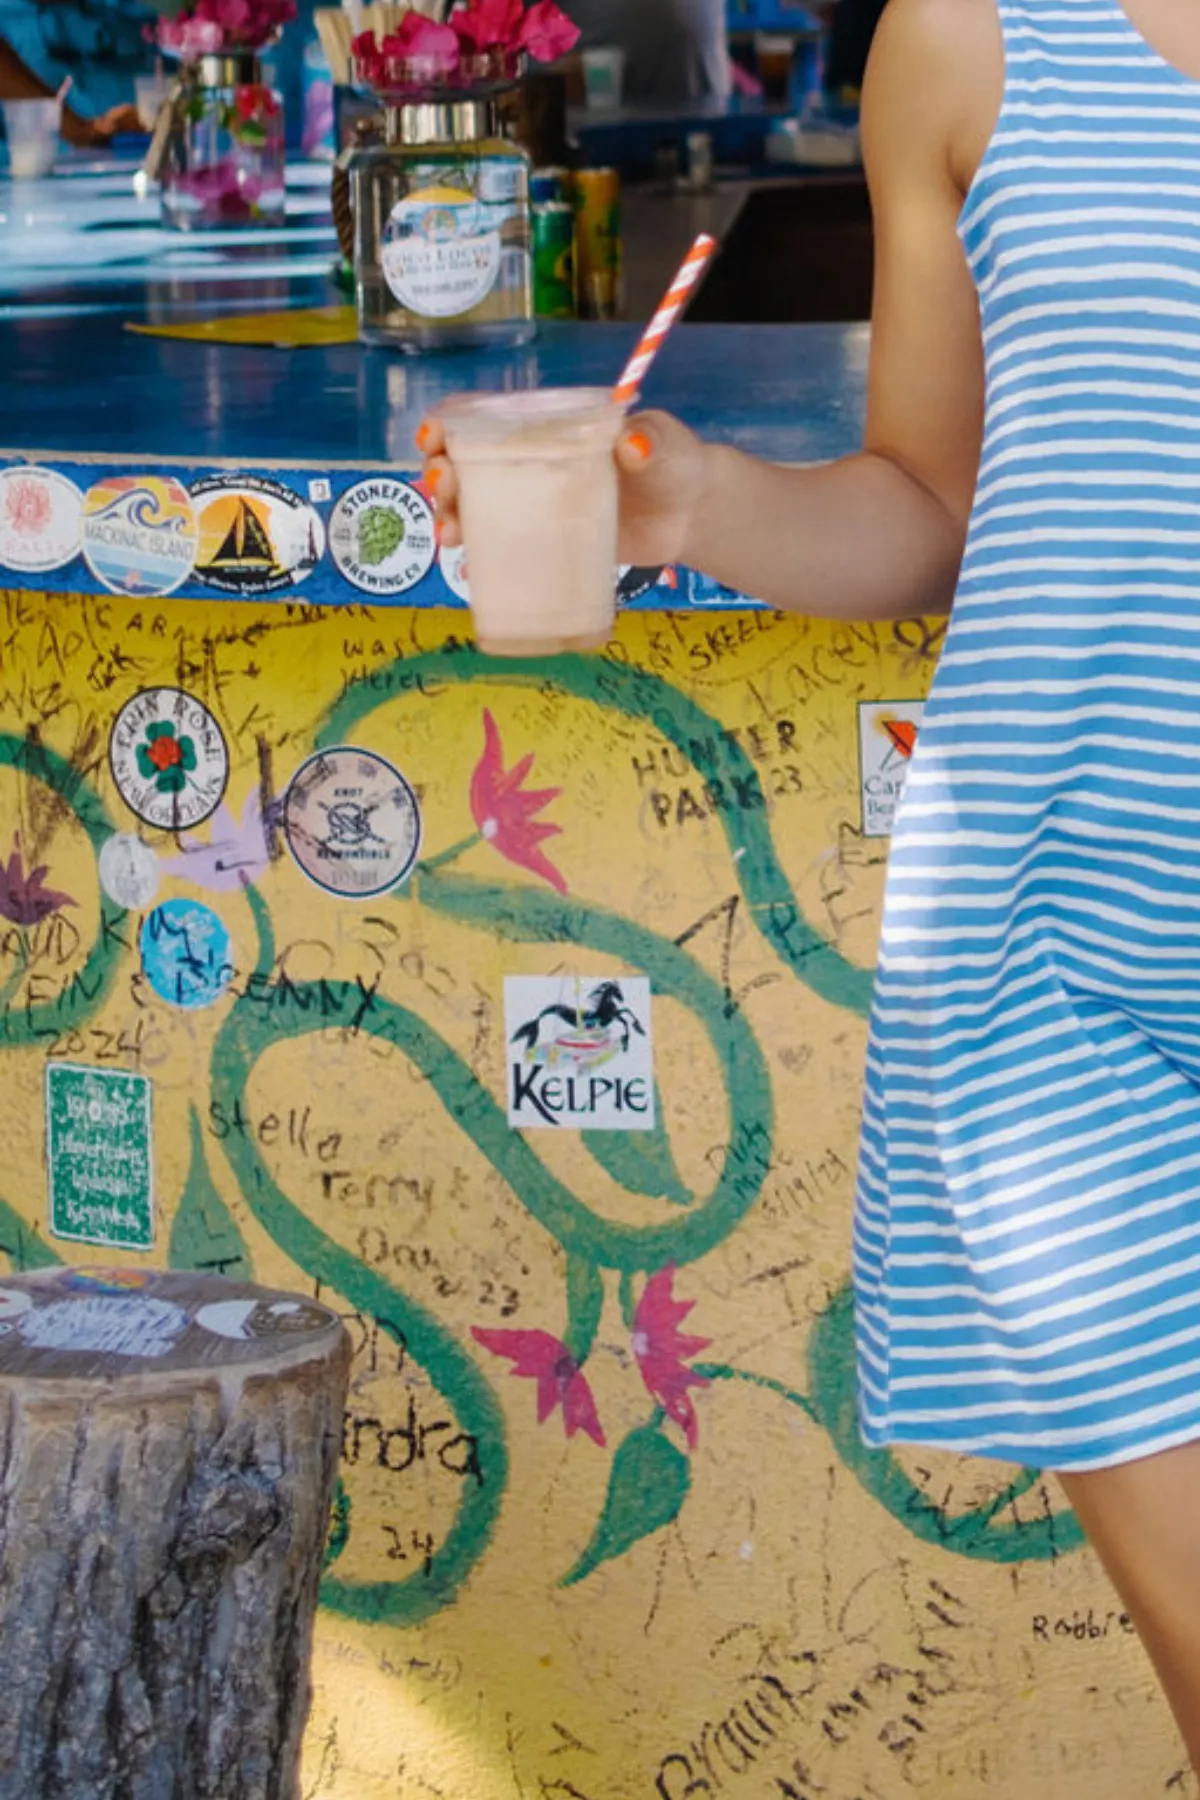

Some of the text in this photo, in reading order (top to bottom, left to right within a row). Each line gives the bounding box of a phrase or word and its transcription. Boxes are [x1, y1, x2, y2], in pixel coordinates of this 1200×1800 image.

[341, 482, 428, 523] STONEFACE
[149, 532, 194, 563] ISLAND
[341, 554, 403, 589] BREWING
[116, 690, 222, 762] ERIN ROSE
[631, 718, 802, 788] HUNTER
[650, 770, 762, 828] PARK
[44, 1018, 143, 1067] 2024
[511, 1061, 649, 1126] KELPIE
